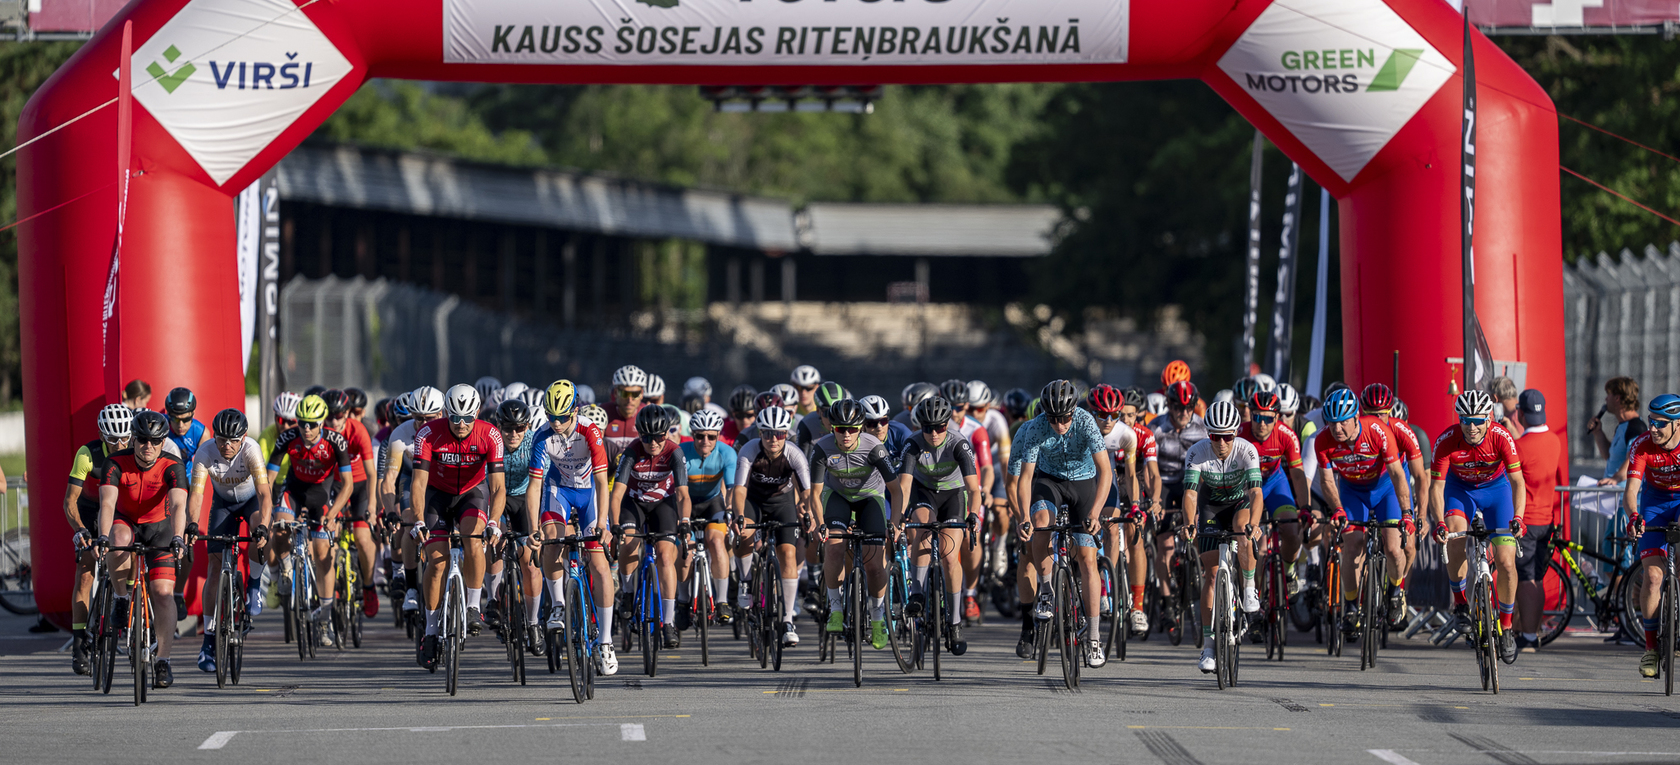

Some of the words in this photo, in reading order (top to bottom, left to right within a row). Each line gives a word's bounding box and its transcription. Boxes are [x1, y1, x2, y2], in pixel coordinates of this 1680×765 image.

[491, 25, 605, 54] KAUSS
[614, 18, 765, 55] ŠOSEJAS
[775, 17, 1081, 61] RITEŅBRAUKŠANĀ
[1281, 48, 1375, 70] GREEN
[209, 52, 313, 90] VIRŠI
[1245, 72, 1359, 94] MOTORS
[275, 429, 297, 450] RRS
[326, 430, 348, 452] RRS
[591, 427, 601, 438] FDJ
[1188, 451, 1197, 462] UAE
[1247, 450, 1256, 461] UAE
